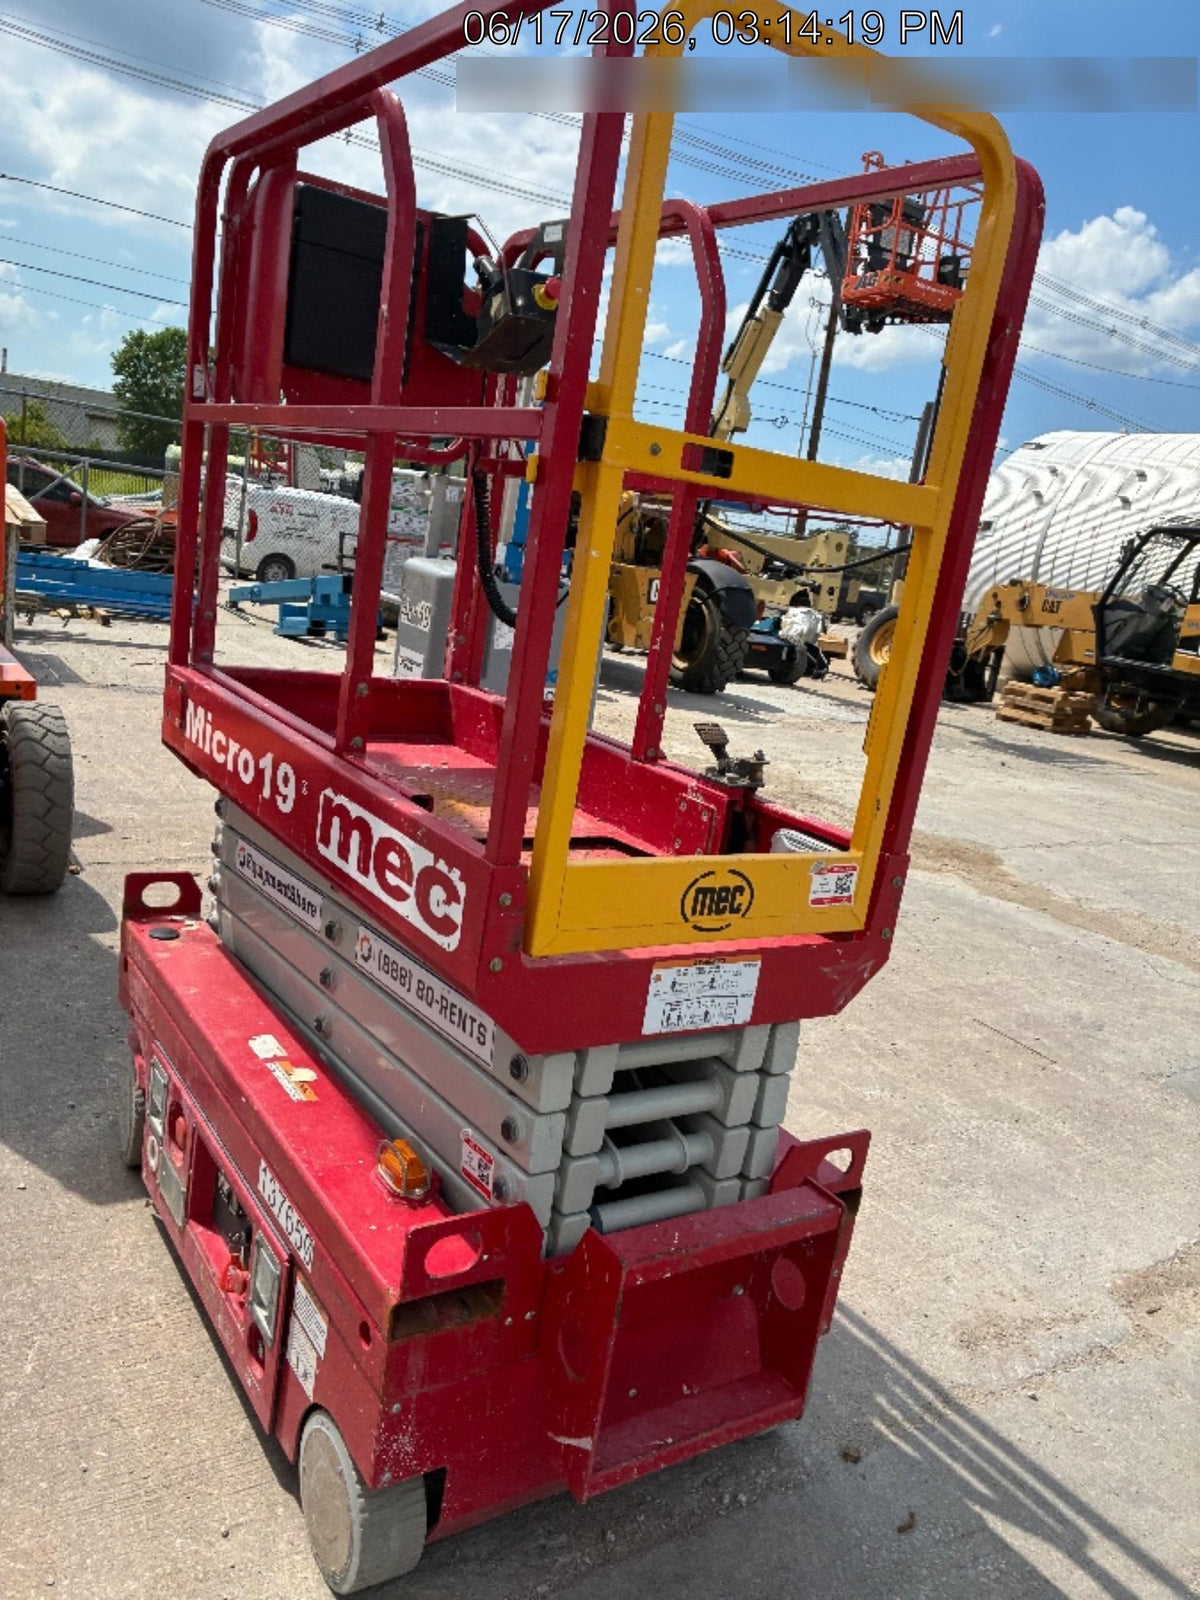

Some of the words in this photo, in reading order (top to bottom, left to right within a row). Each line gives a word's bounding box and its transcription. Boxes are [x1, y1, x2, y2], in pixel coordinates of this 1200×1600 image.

[1042, 599, 1062, 613] CAT
[691, 885, 745, 916] mec
[377, 948, 413, 993] (888)
[416, 978, 488, 1046] 80-RENTS
